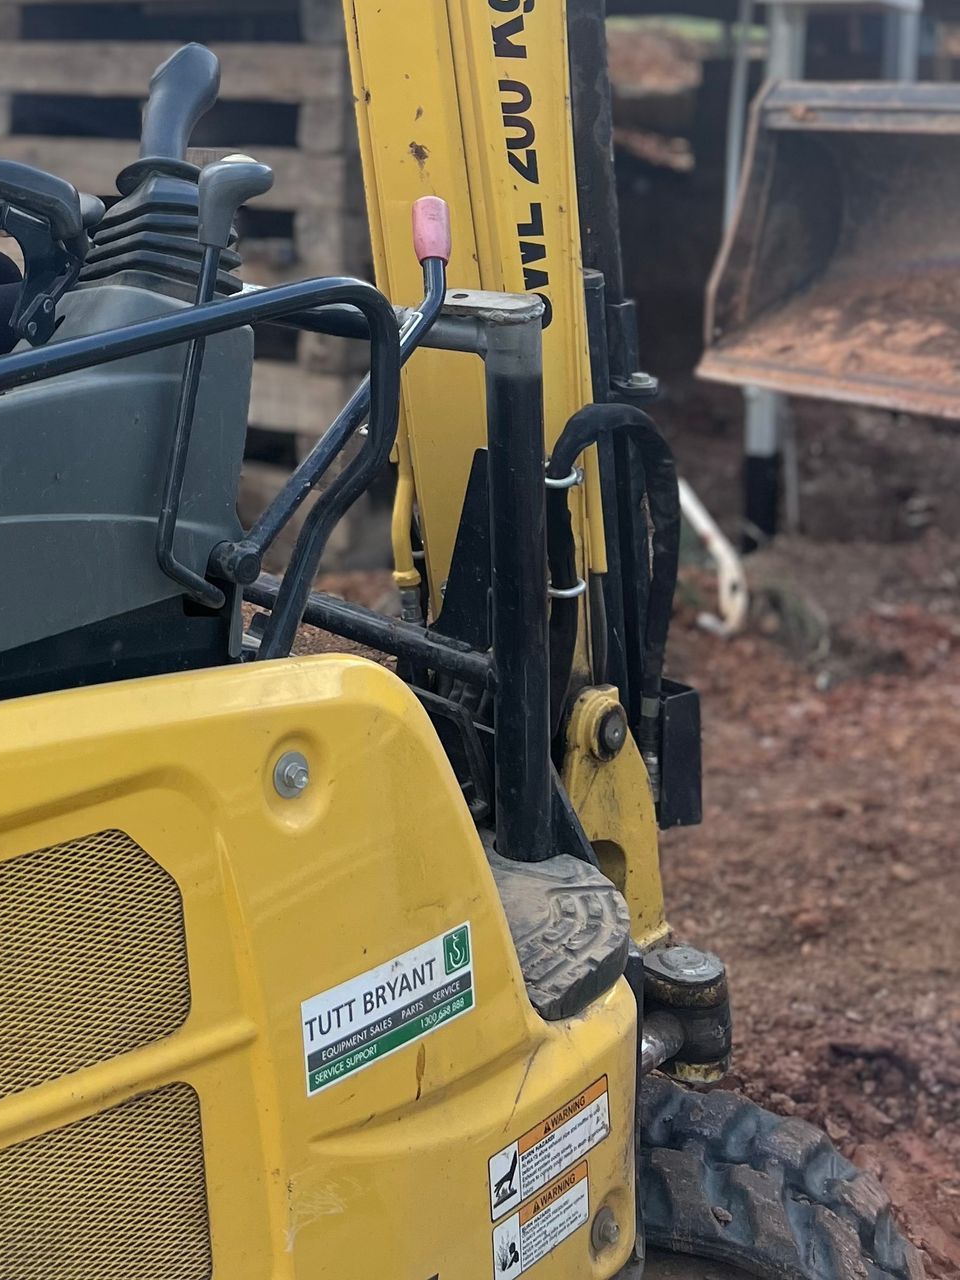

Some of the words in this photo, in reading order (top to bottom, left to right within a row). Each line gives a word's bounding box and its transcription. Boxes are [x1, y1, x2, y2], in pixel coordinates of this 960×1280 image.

[516, 202, 553, 330] WL
[305, 999, 356, 1041] TUTT
[362, 958, 436, 1015] BRYANT
[322, 1031, 367, 1061] EQUIPMENT
[370, 1017, 393, 1036] SALES
[401, 1001, 424, 1019] PARTS
[432, 980, 460, 1003] SERVICE
[314, 1061, 344, 1084] SERVICE
[346, 1044, 377, 1068] SUPPORT
[420, 1012, 437, 1028] 1300
[551, 1095, 586, 1130] WARNING
[540, 1173, 576, 1206] WARNING
